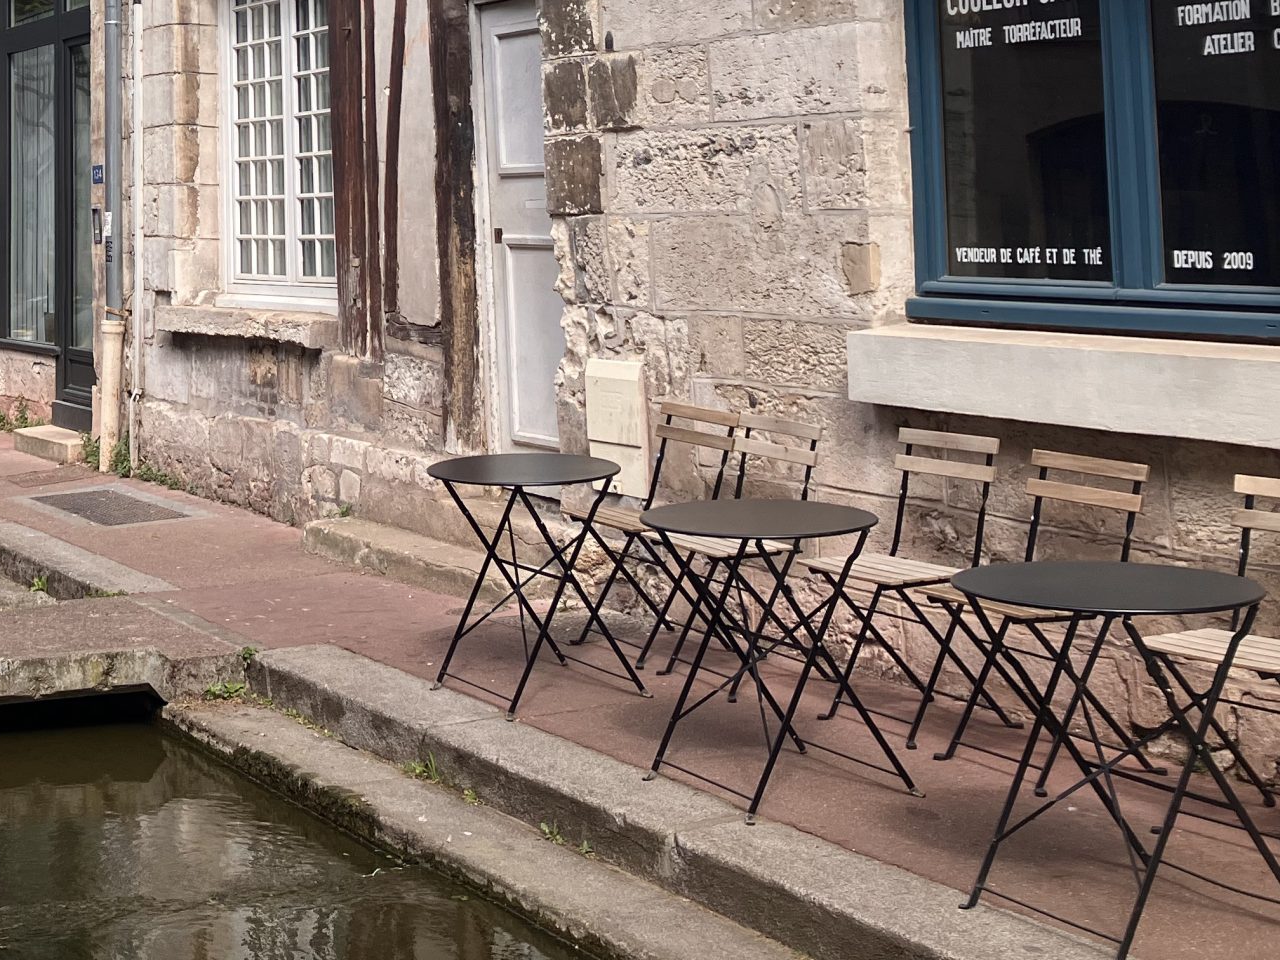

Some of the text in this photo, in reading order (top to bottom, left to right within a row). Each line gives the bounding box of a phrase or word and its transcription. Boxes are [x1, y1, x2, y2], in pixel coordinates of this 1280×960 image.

[1177, 0, 1251, 26] FORMATION
[1003, 17, 1082, 44] TORRÉFACTEUR
[1203, 31, 1255, 56] ATELIER
[955, 246, 1103, 265] VENDEUR DE CAFÉ ET DE THÉ
[1173, 250, 1254, 270] DEPUIS 2009
